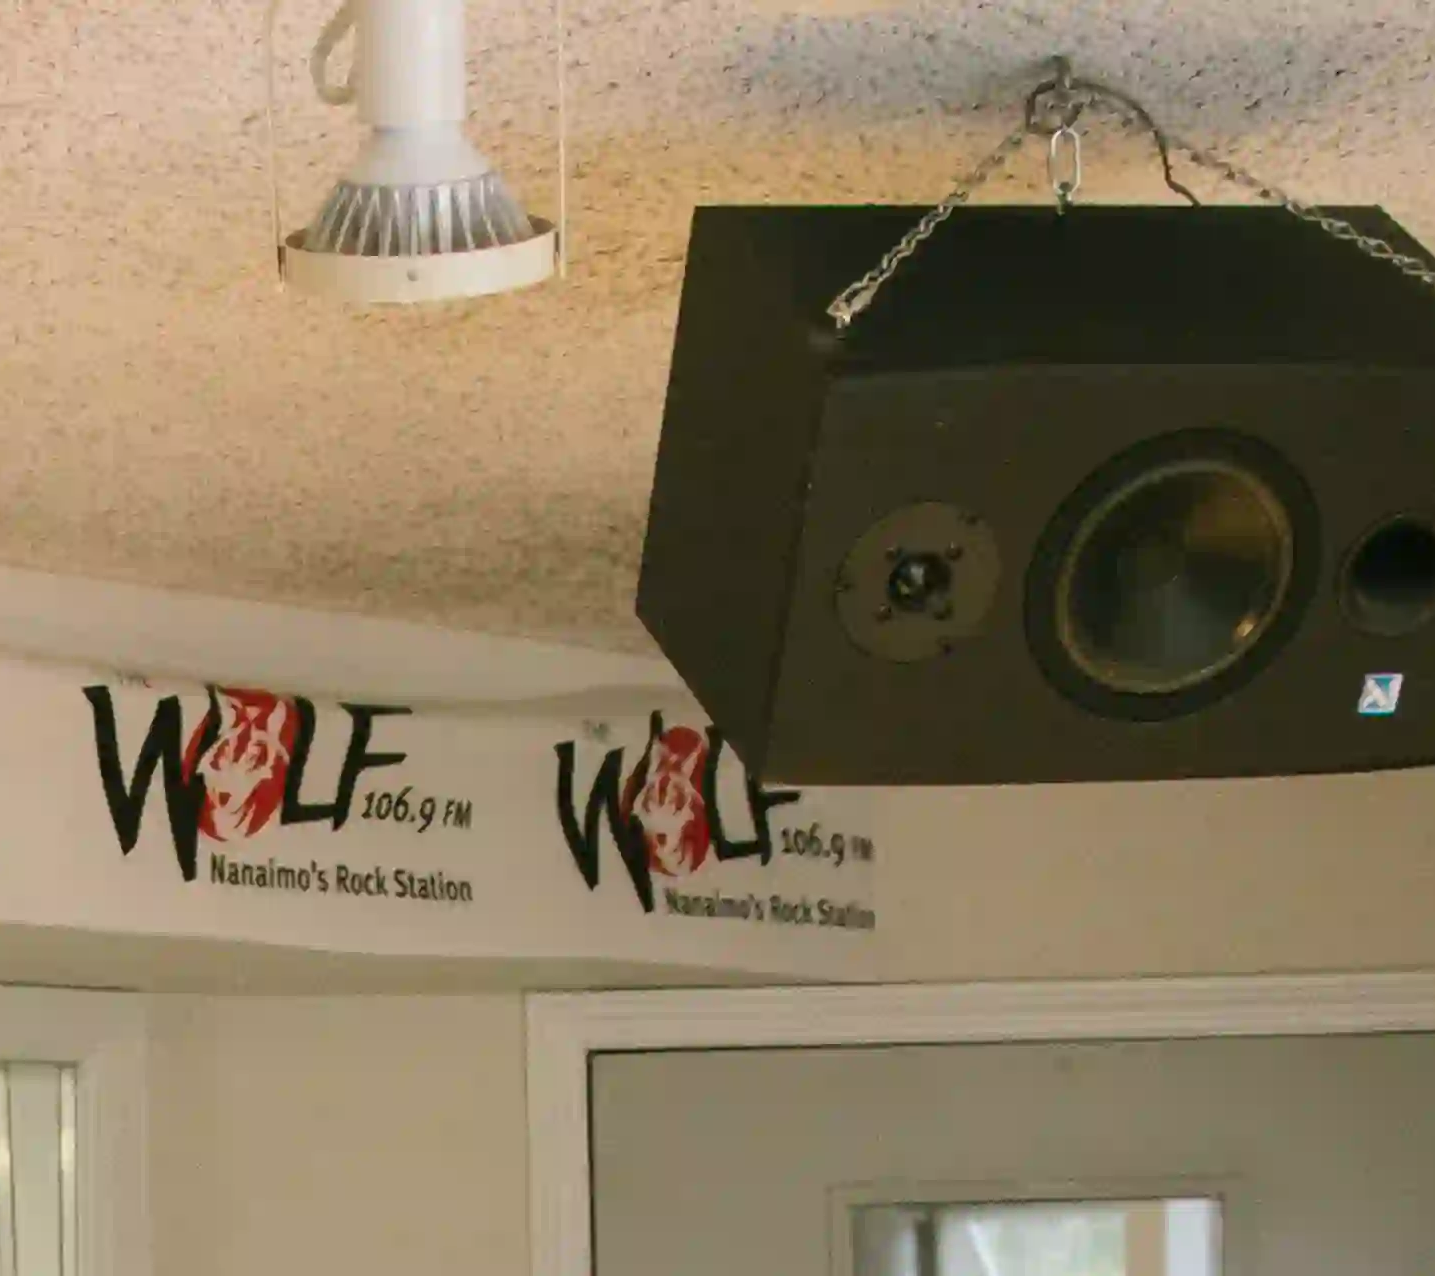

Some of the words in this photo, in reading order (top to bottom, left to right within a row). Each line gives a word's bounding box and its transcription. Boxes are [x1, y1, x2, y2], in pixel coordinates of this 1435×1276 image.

[82, 683, 412, 883] WOLF
[361, 785, 436, 835] 106.9
[442, 800, 472, 831] FM
[780, 826, 845, 866] 106.9
[210, 851, 330, 896] Nanaimo's
[336, 863, 389, 900] Rock
[394, 869, 474, 904] Station
